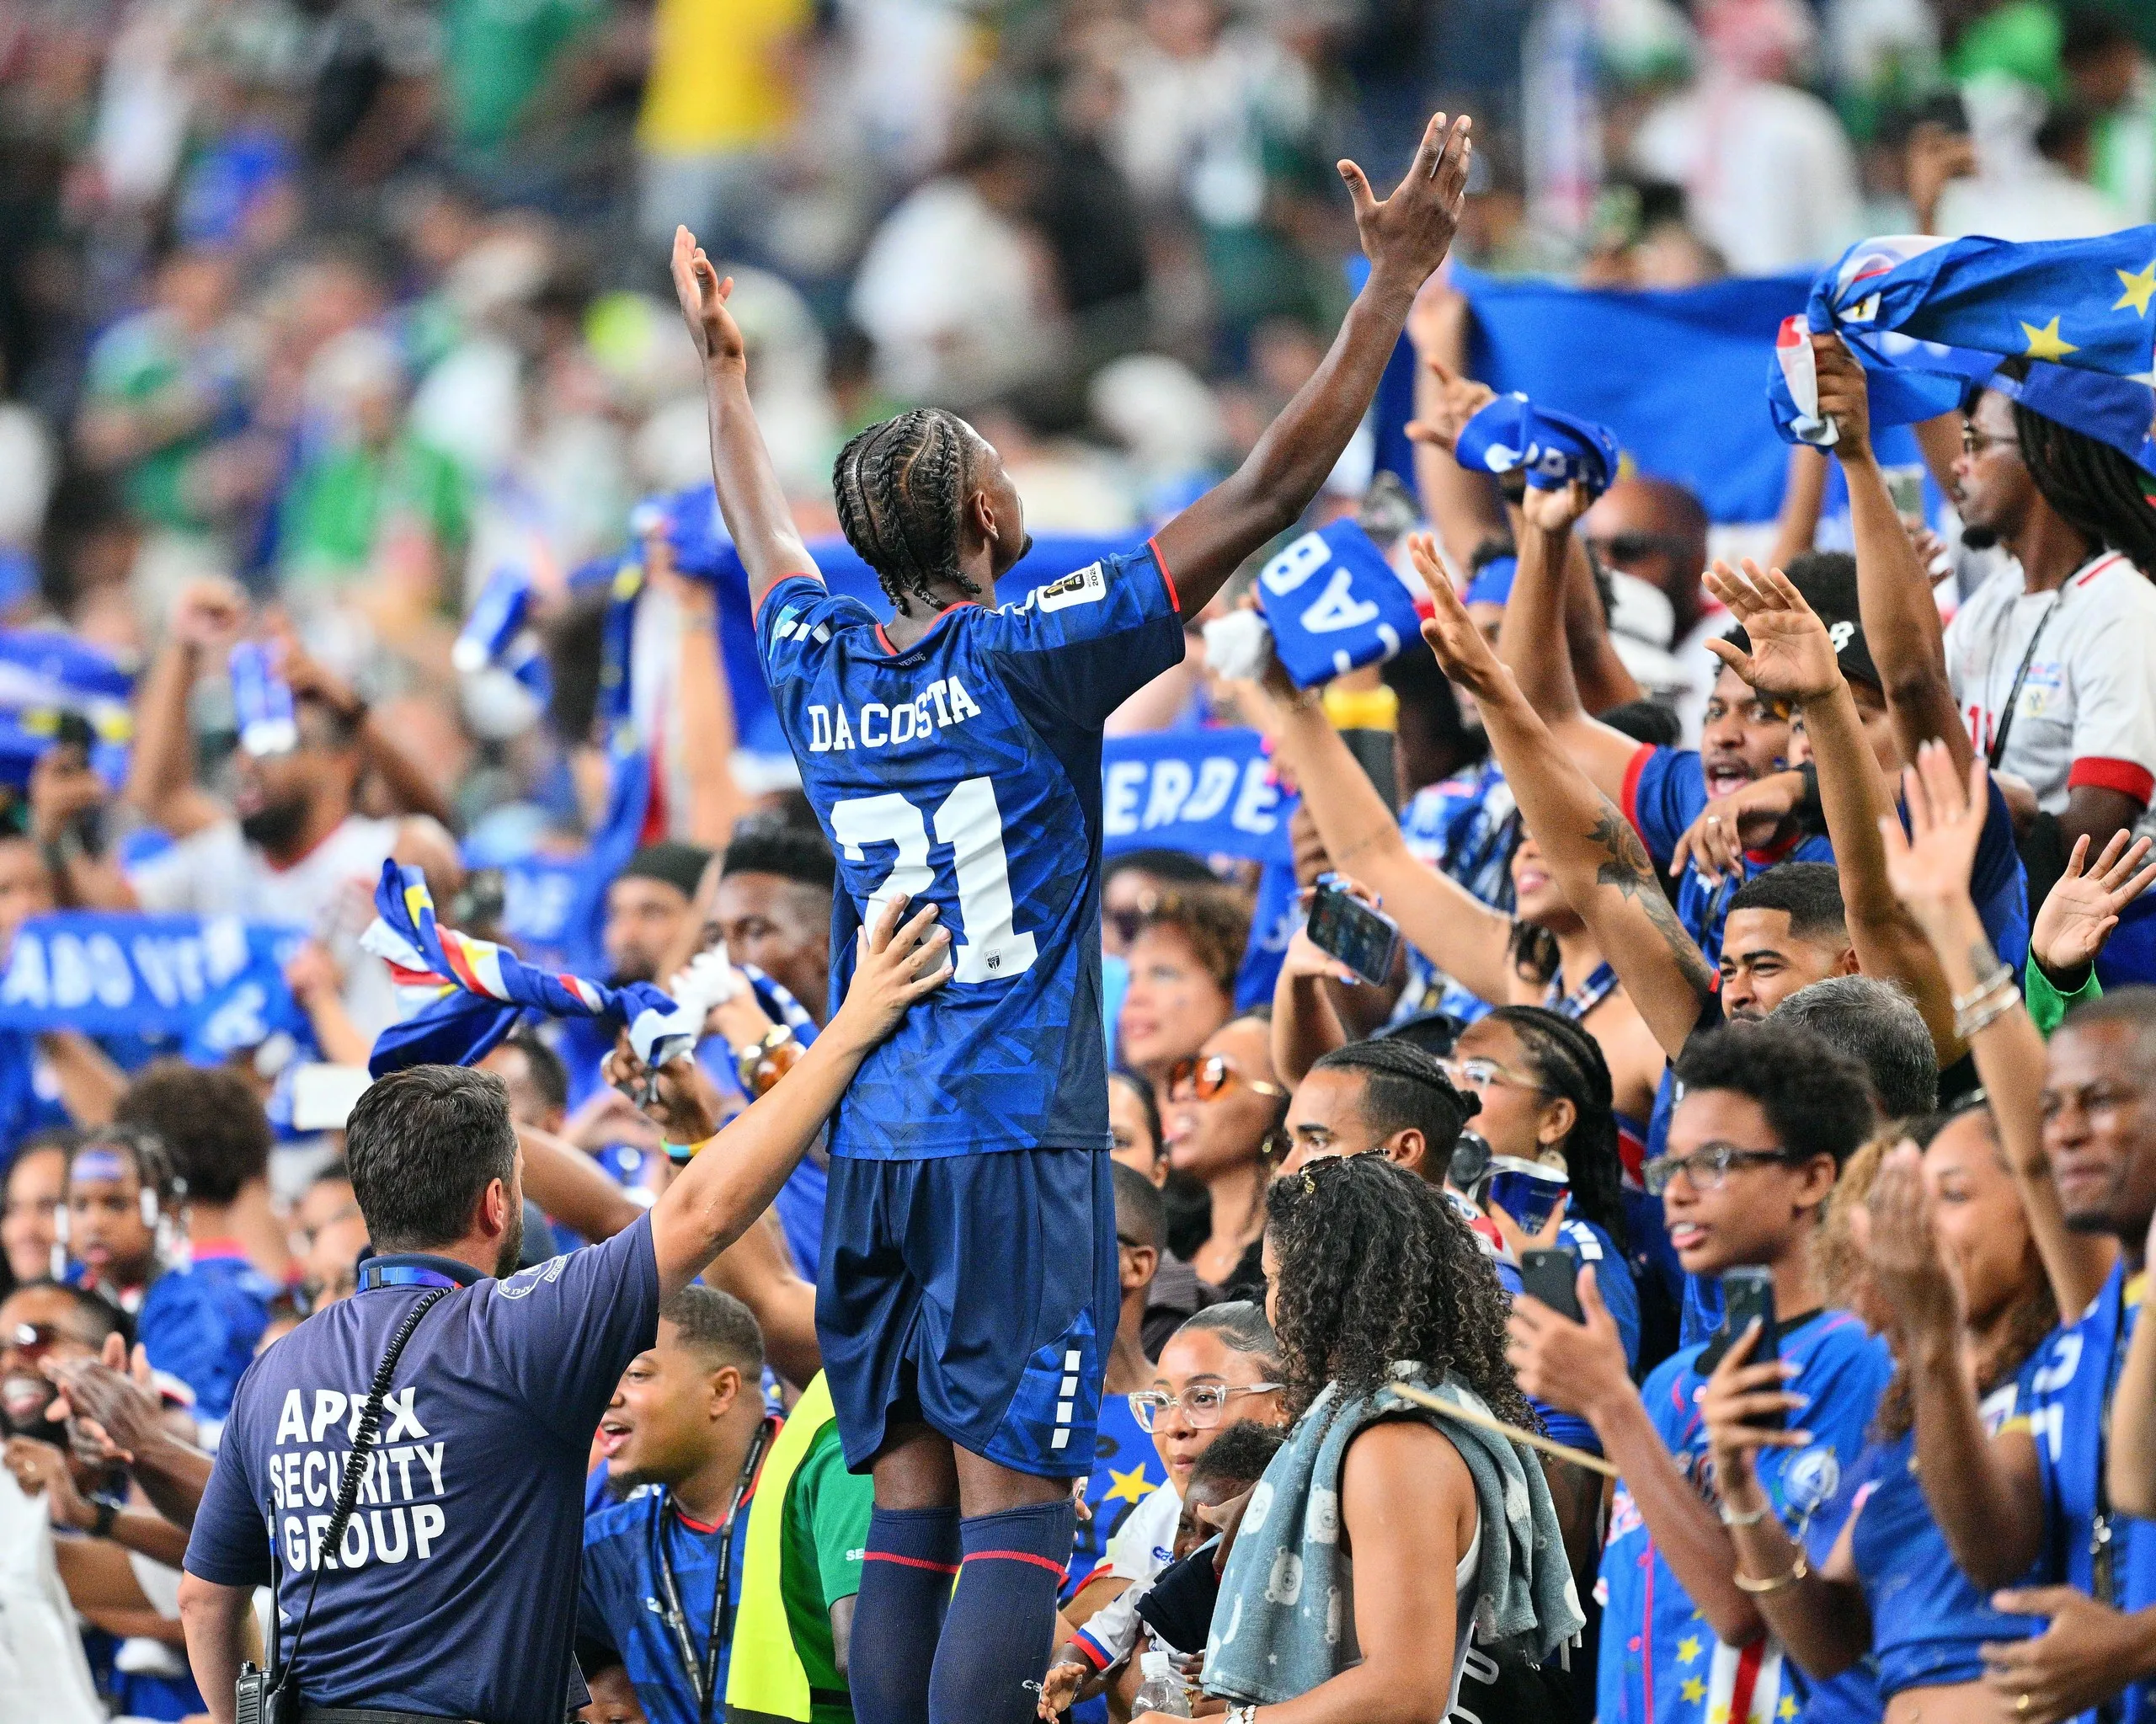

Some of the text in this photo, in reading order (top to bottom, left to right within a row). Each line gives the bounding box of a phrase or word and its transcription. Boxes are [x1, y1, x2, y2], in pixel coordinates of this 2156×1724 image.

[1829, 620, 1855, 654] B
[807, 675, 982, 752] DA COSTA
[830, 776, 1038, 985] 21
[275, 1386, 430, 1446] APEX
[269, 1441, 446, 1510] SECURITY
[284, 1503, 446, 1572] GROUP
